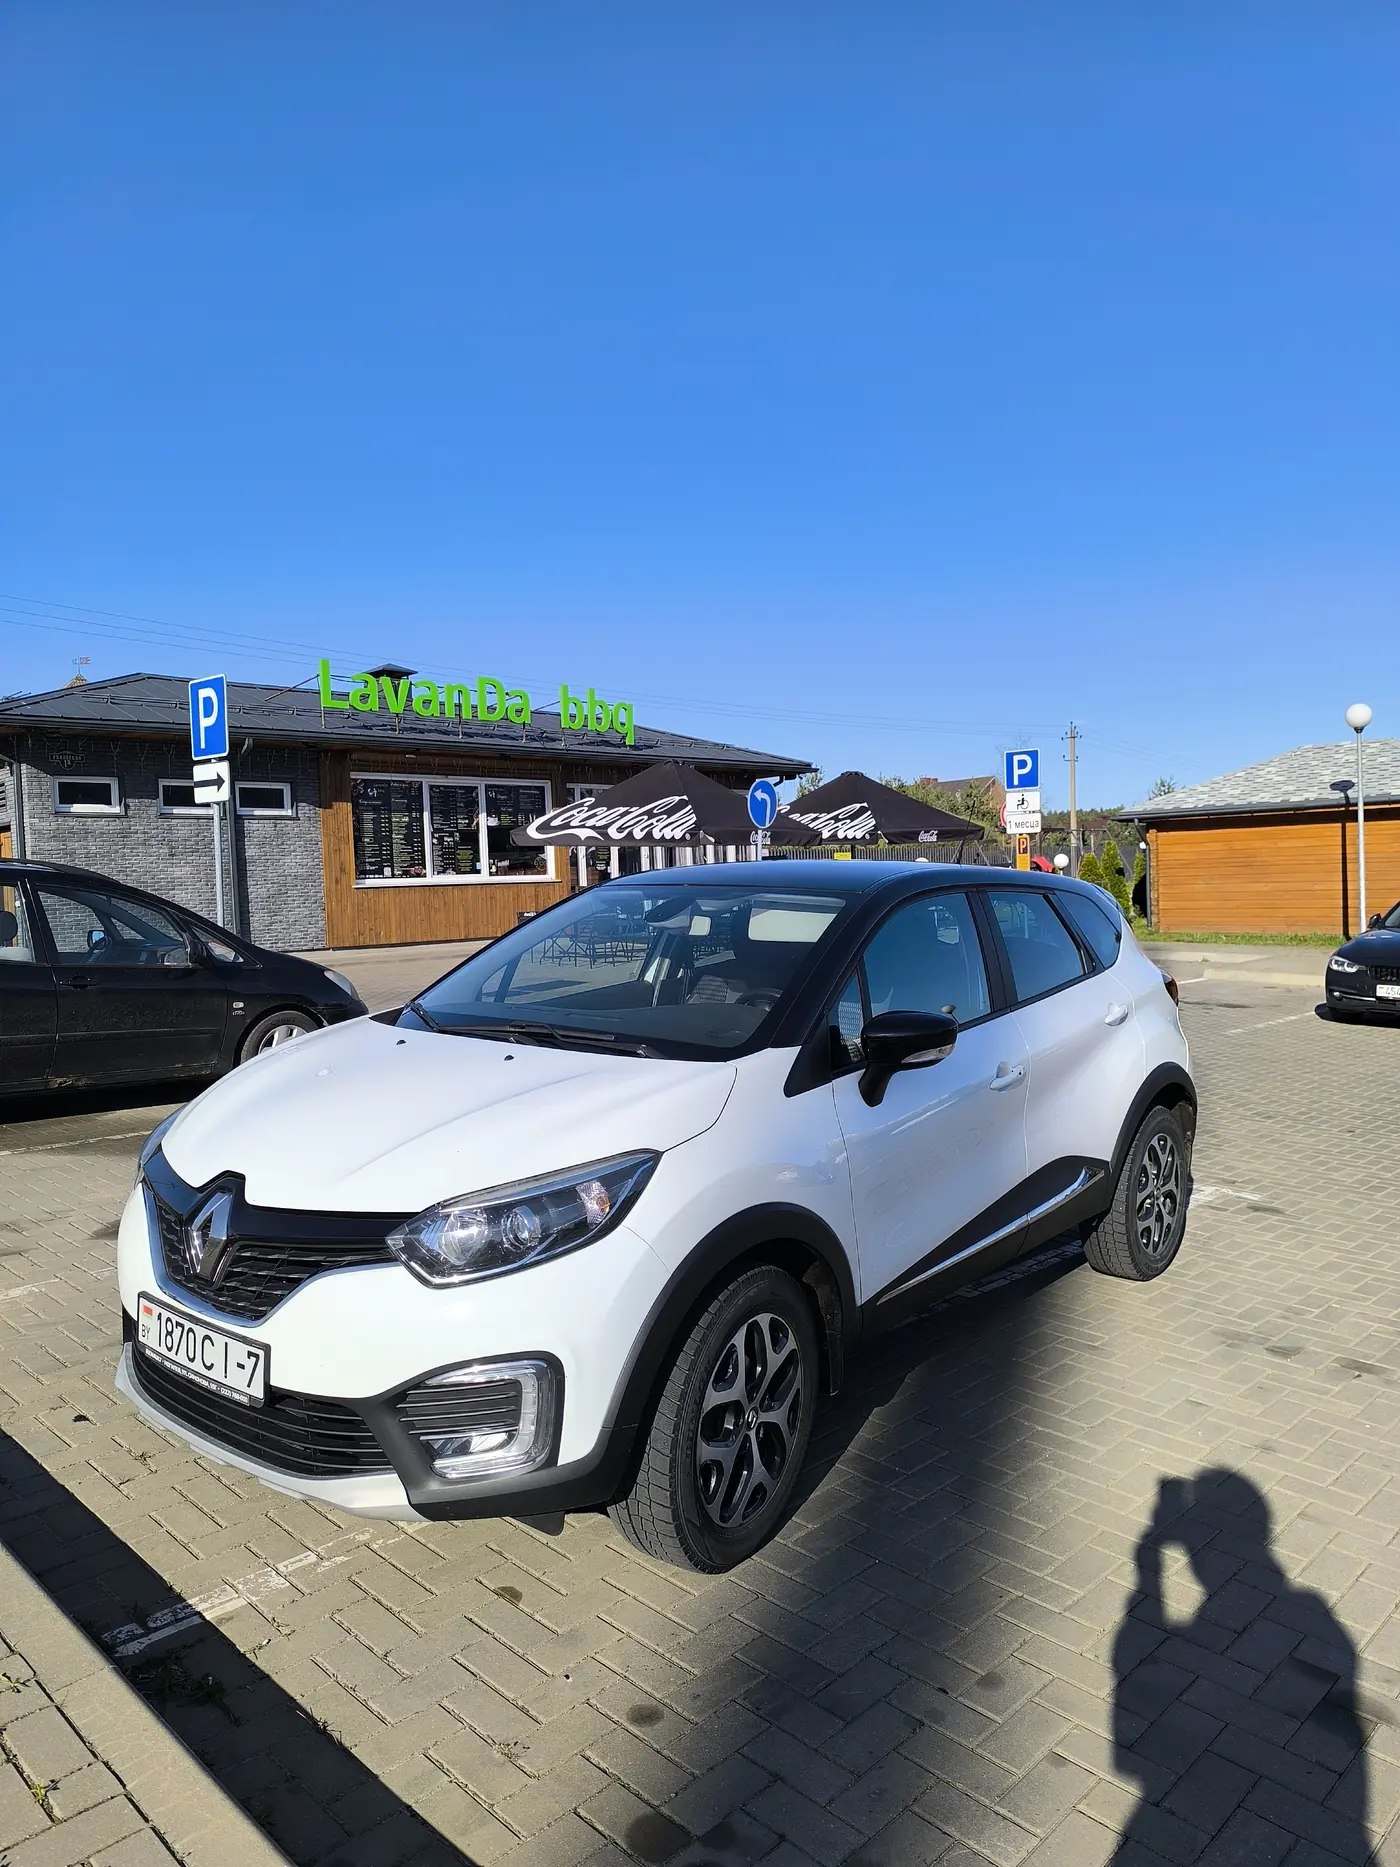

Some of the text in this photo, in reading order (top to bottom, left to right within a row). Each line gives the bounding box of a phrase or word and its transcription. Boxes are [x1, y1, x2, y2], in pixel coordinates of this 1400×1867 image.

[318, 658, 635, 746] LavanDa bbq
[198, 687, 218, 750] P
[1012, 754, 1032, 786] P
[1015, 819, 1040, 830] месца
[141, 1323, 151, 1341] BY
